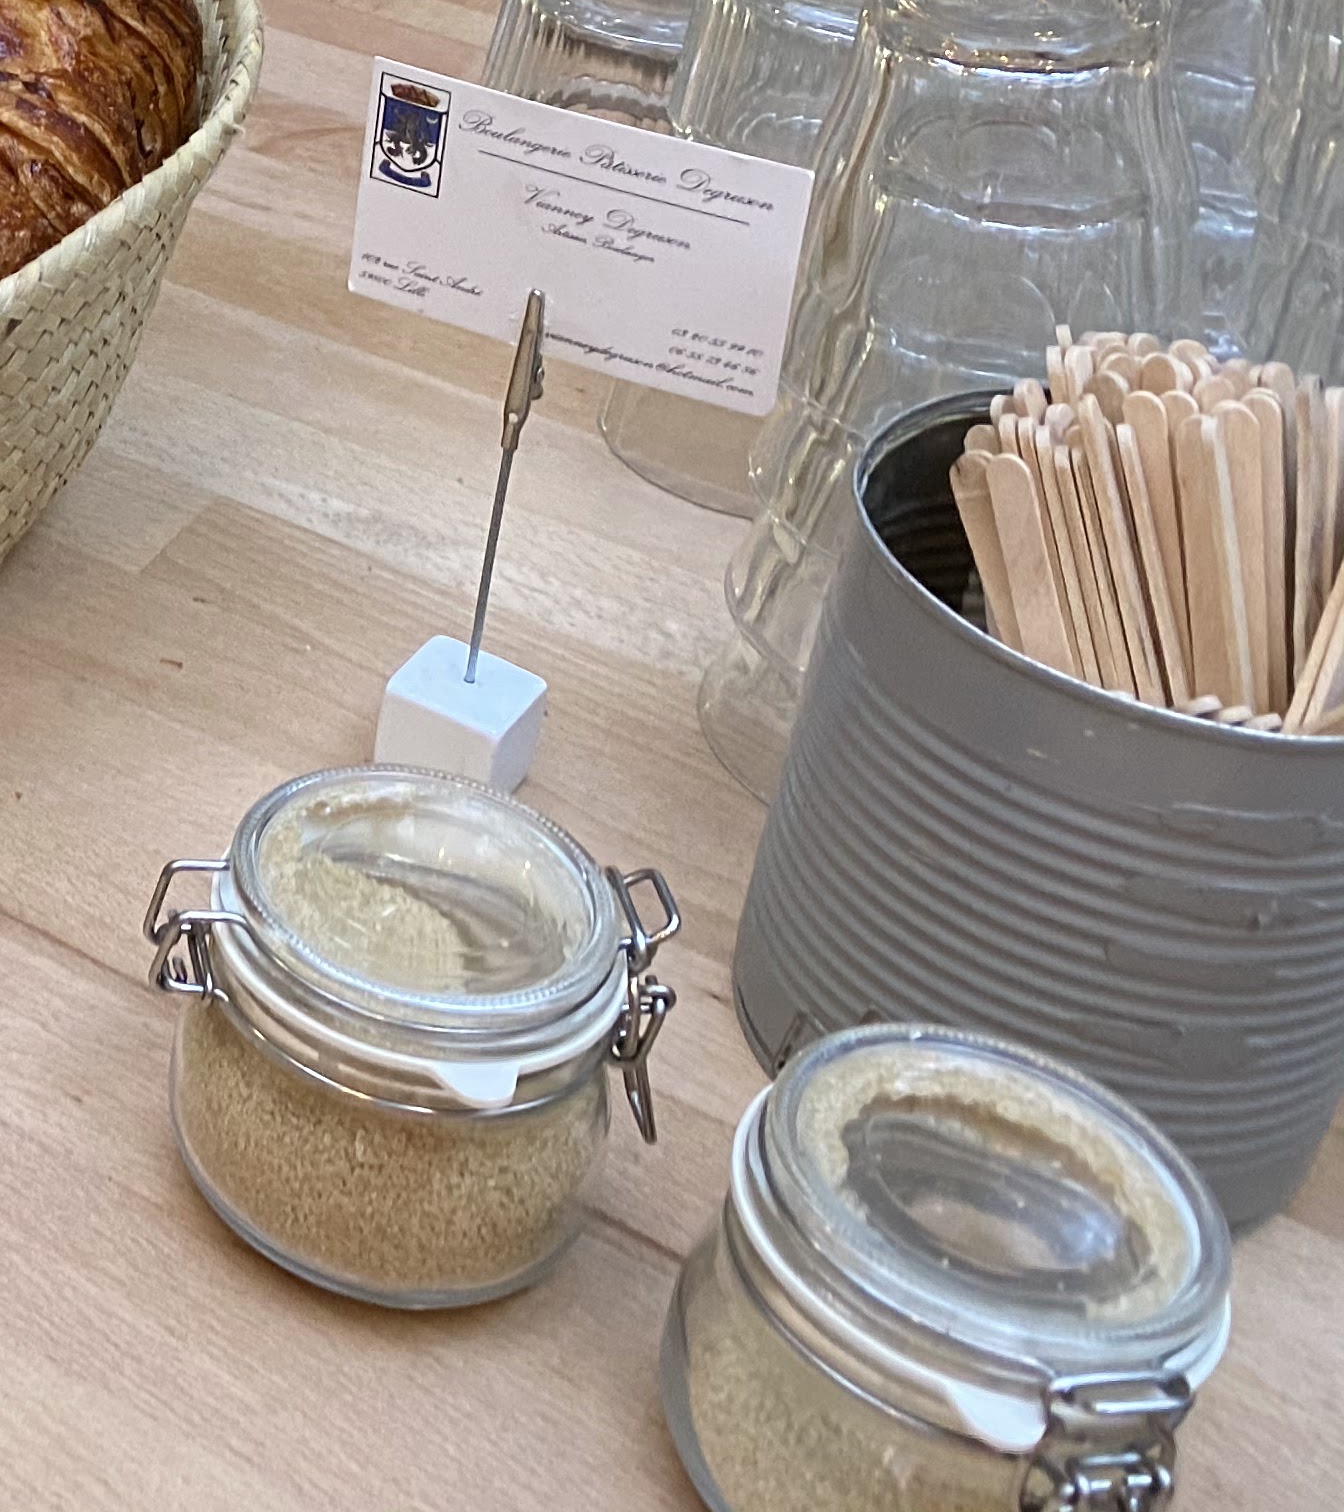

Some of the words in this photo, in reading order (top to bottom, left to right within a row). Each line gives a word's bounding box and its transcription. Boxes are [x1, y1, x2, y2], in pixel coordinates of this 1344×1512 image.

[458, 109, 571, 157] Boulangerie
[676, 168, 775, 212] Degruson
[523, 184, 594, 225] Vianney
[602, 209, 691, 250] Degruson
